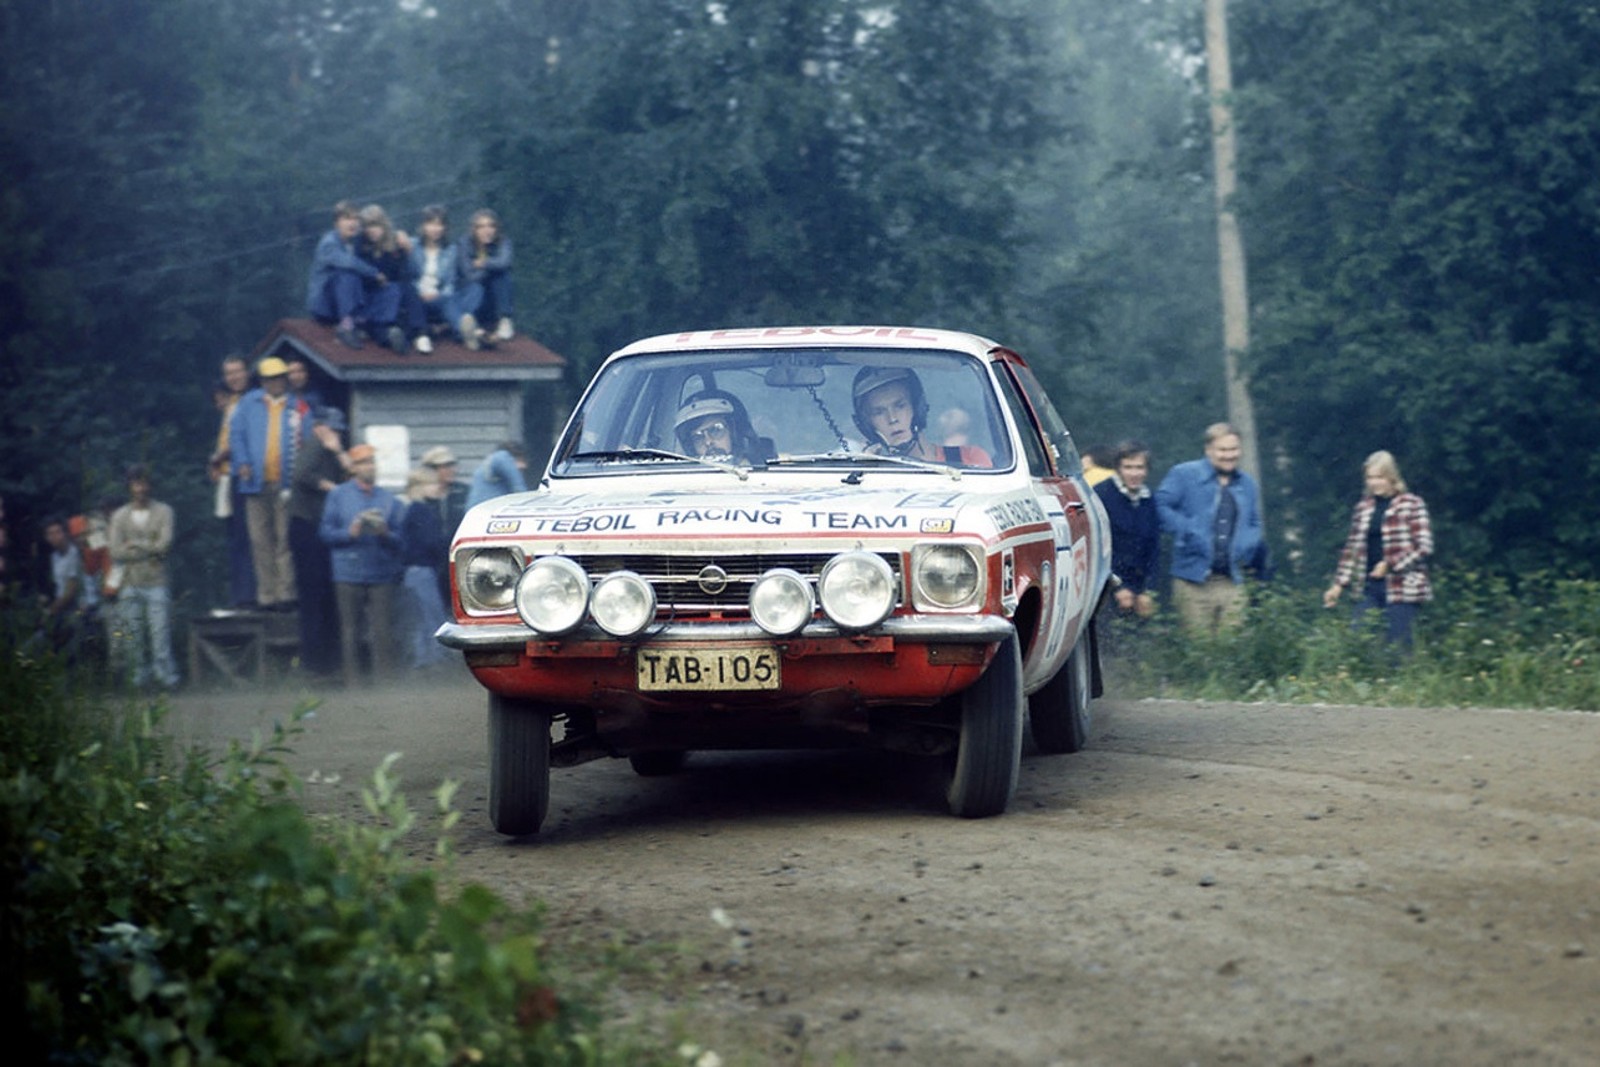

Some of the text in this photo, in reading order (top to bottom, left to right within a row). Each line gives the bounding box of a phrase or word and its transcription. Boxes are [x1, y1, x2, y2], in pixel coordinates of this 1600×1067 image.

[535, 508, 907, 533] TEBOIL RACING TEAM
[643, 654, 773, 684] TAB-105
